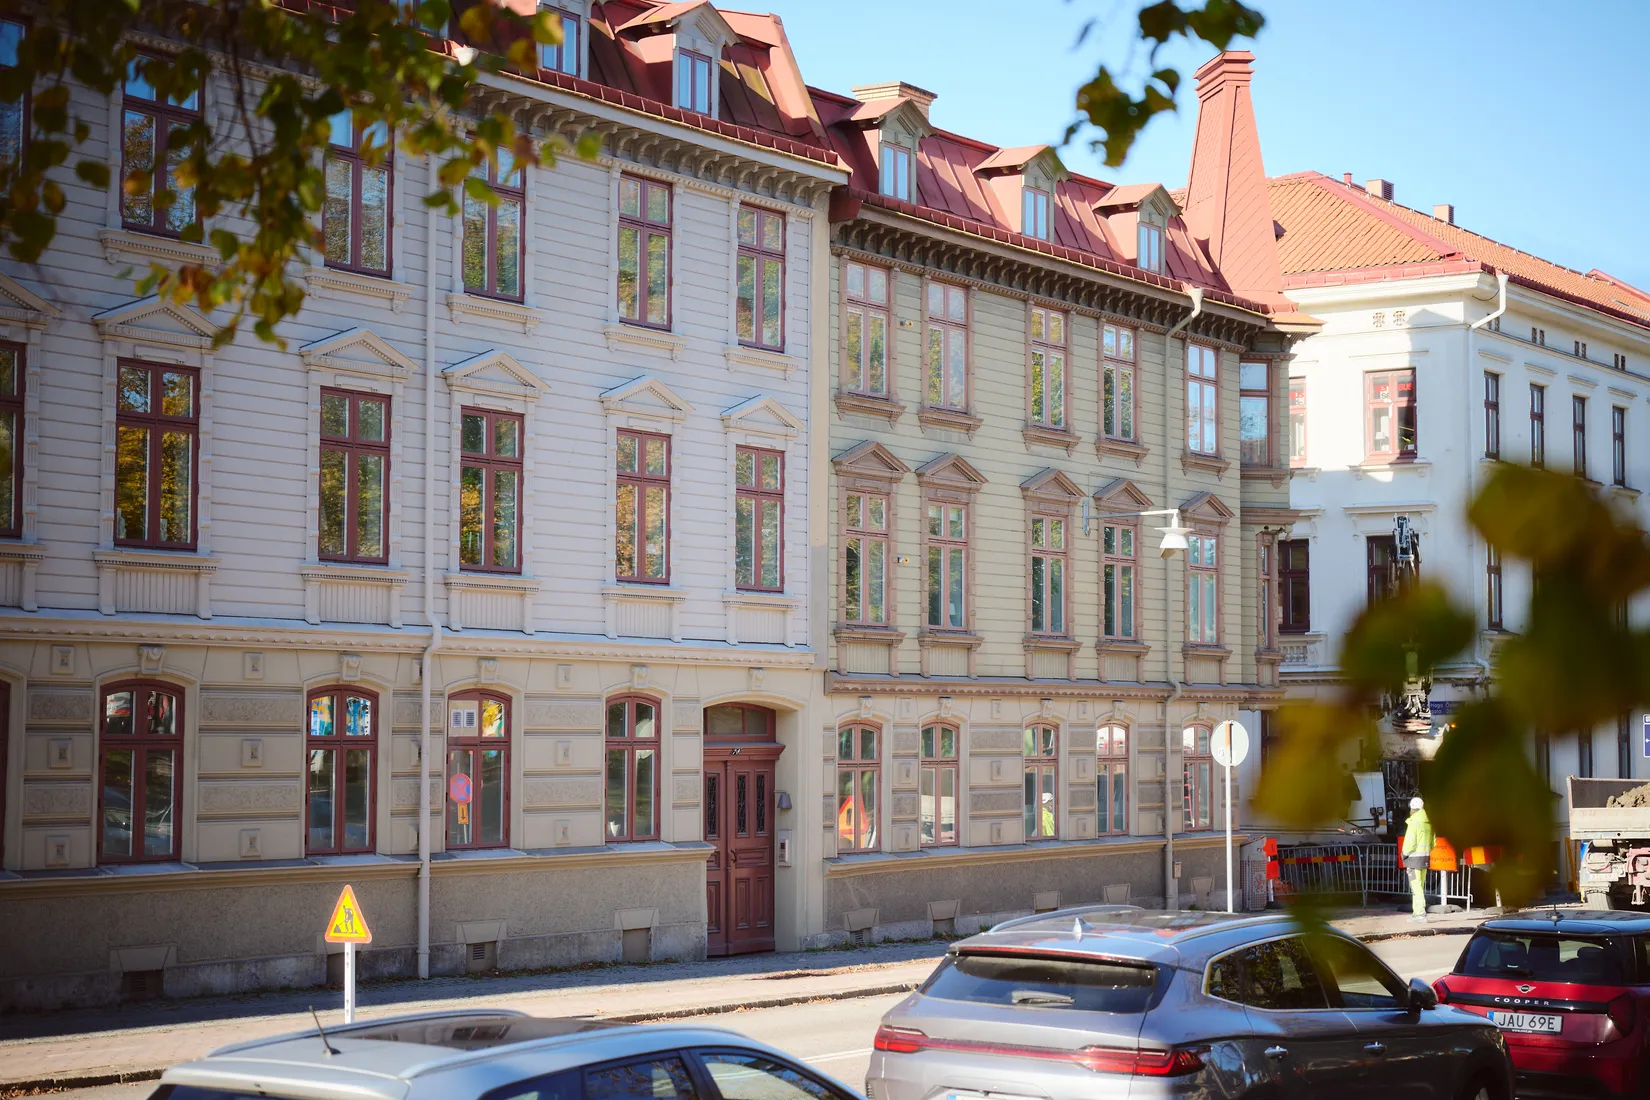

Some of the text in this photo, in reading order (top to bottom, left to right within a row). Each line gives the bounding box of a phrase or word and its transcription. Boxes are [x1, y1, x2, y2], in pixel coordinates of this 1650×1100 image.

[1494, 997, 1550, 1006] COOPER
[1498, 1014, 1555, 1030] JAU 69E
